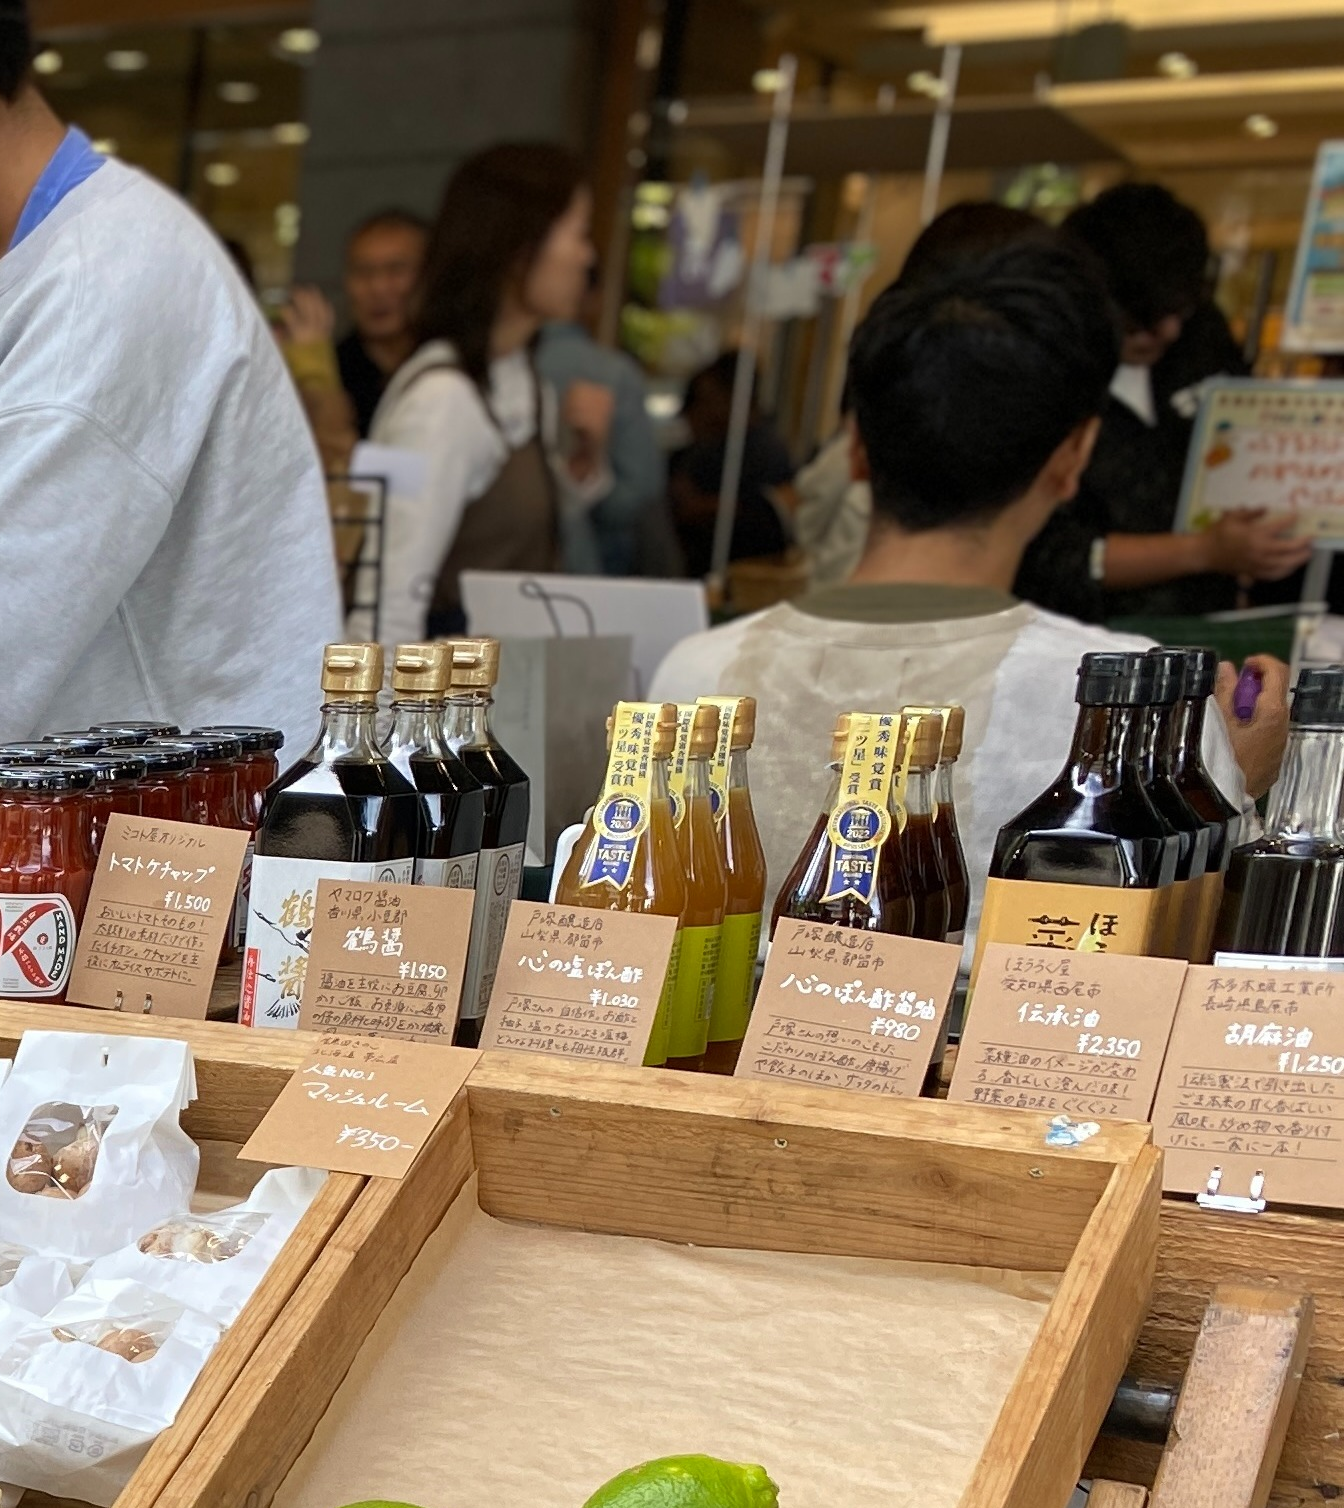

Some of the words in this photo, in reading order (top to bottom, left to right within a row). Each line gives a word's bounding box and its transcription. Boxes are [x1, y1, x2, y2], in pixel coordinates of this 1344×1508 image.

[108, 852, 216, 884] トマトケチャップ
[597, 849, 631, 862] TASTE
[835, 859, 874, 873] TASTE
[164, 890, 211, 913] ¥1,500
[328, 887, 402, 909] ヤマロク醤油
[341, 925, 405, 958] 鶴醤
[517, 949, 645, 984] 心の塩ぽん酢
[1004, 956, 1072, 977] ほうろく屋
[779, 973, 937, 1021] 心のぽん酢醤油
[870, 1015, 921, 1042] ¥980
[1017, 1001, 1101, 1029] 伝承油
[1224, 1022, 1314, 1049] 胡麻油
[301, 1081, 430, 1116] マッシュルーム
